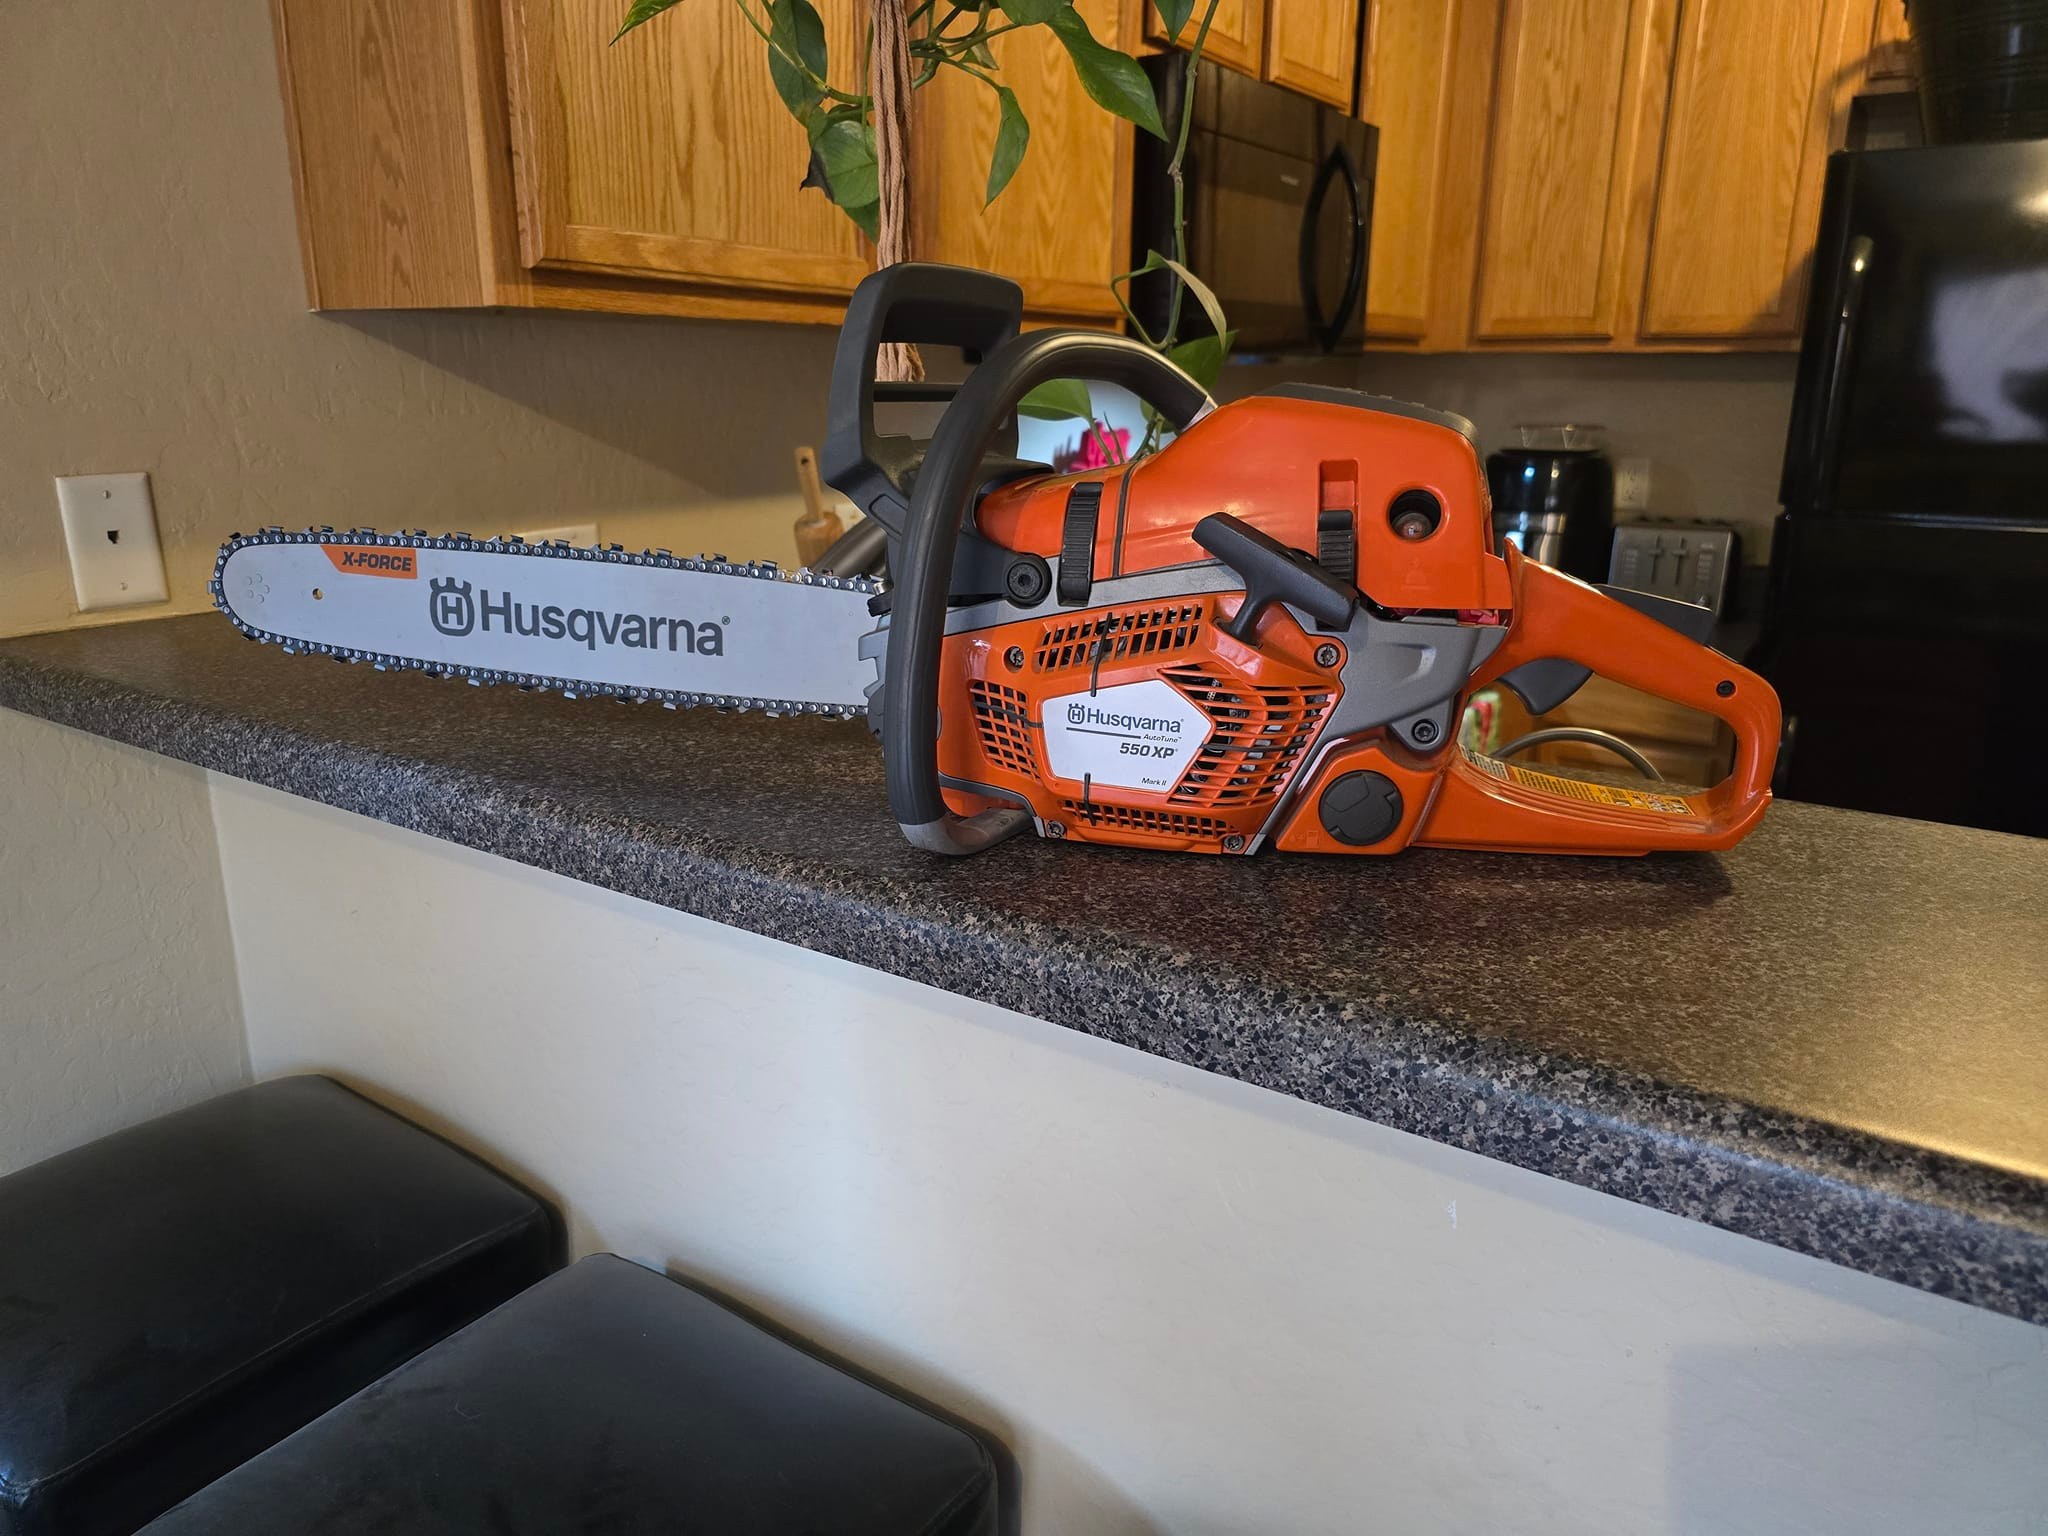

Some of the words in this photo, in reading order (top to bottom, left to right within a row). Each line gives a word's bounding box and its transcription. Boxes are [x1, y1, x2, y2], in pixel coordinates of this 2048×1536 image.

[342, 551, 412, 572] X-FORCE
[480, 589, 724, 657] Husqvarna
[1087, 708, 1181, 733] Husqvarna
[1119, 742, 1150, 756] 550
[1141, 777, 1160, 786] Mark
